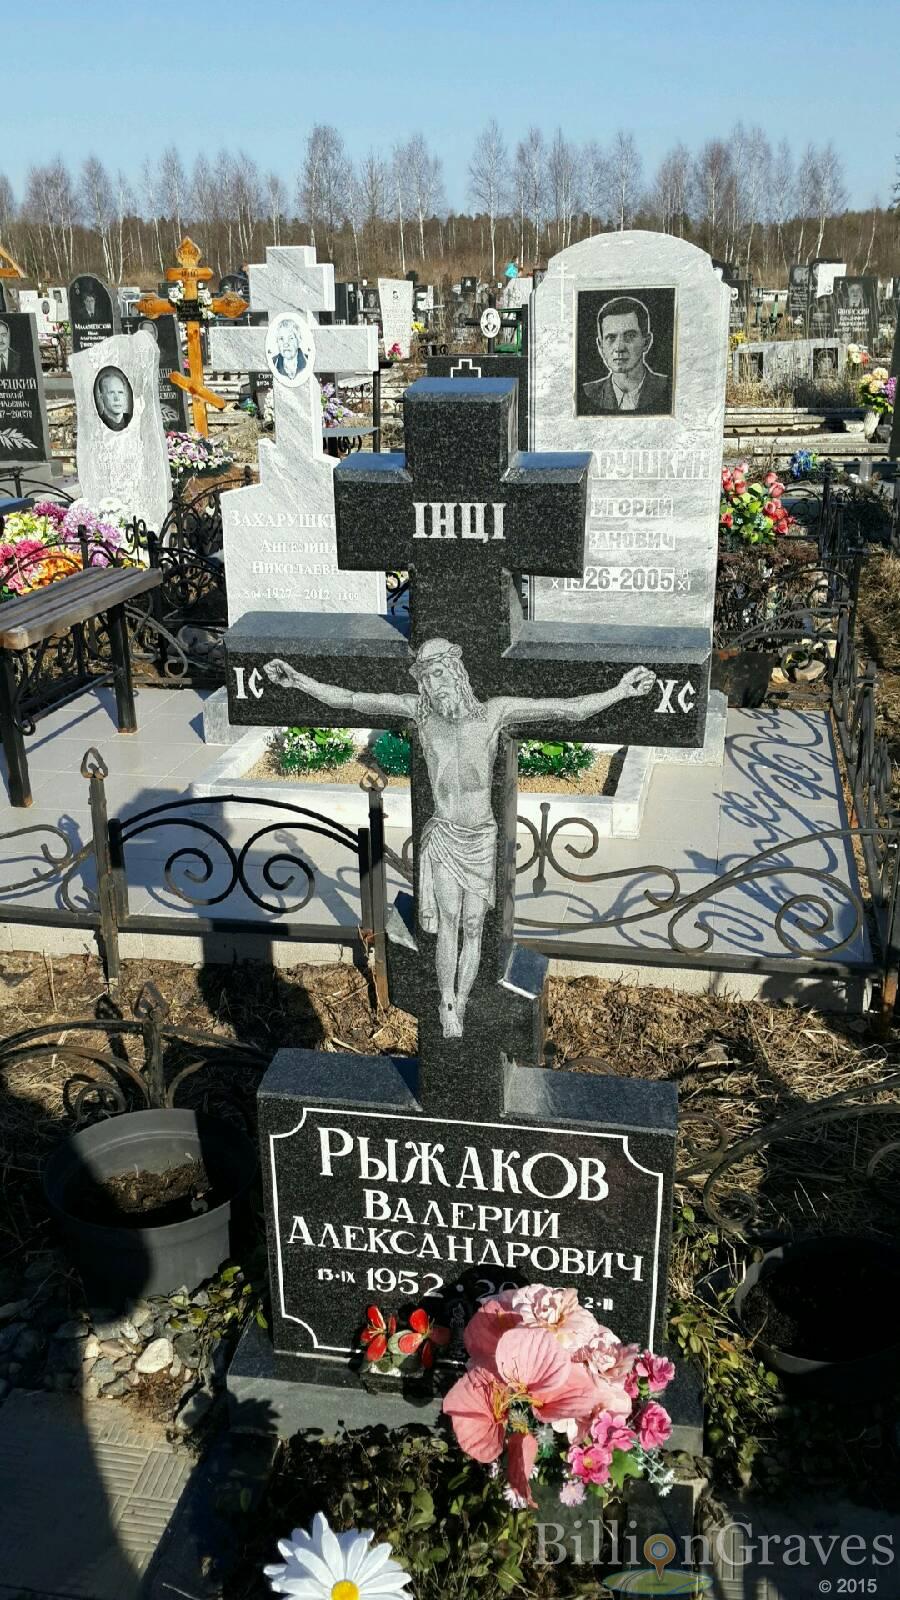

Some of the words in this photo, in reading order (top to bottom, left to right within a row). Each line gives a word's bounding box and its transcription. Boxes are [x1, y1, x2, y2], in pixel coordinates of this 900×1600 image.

[316, 1126, 610, 1202] РЫЖАКОВ
[362, 1188, 562, 1240] ВАЛЕРИЙ
[287, 1215, 644, 1282] АЛЕКСАНДРОВИЧ
[366, 1267, 444, 1298] 1952
